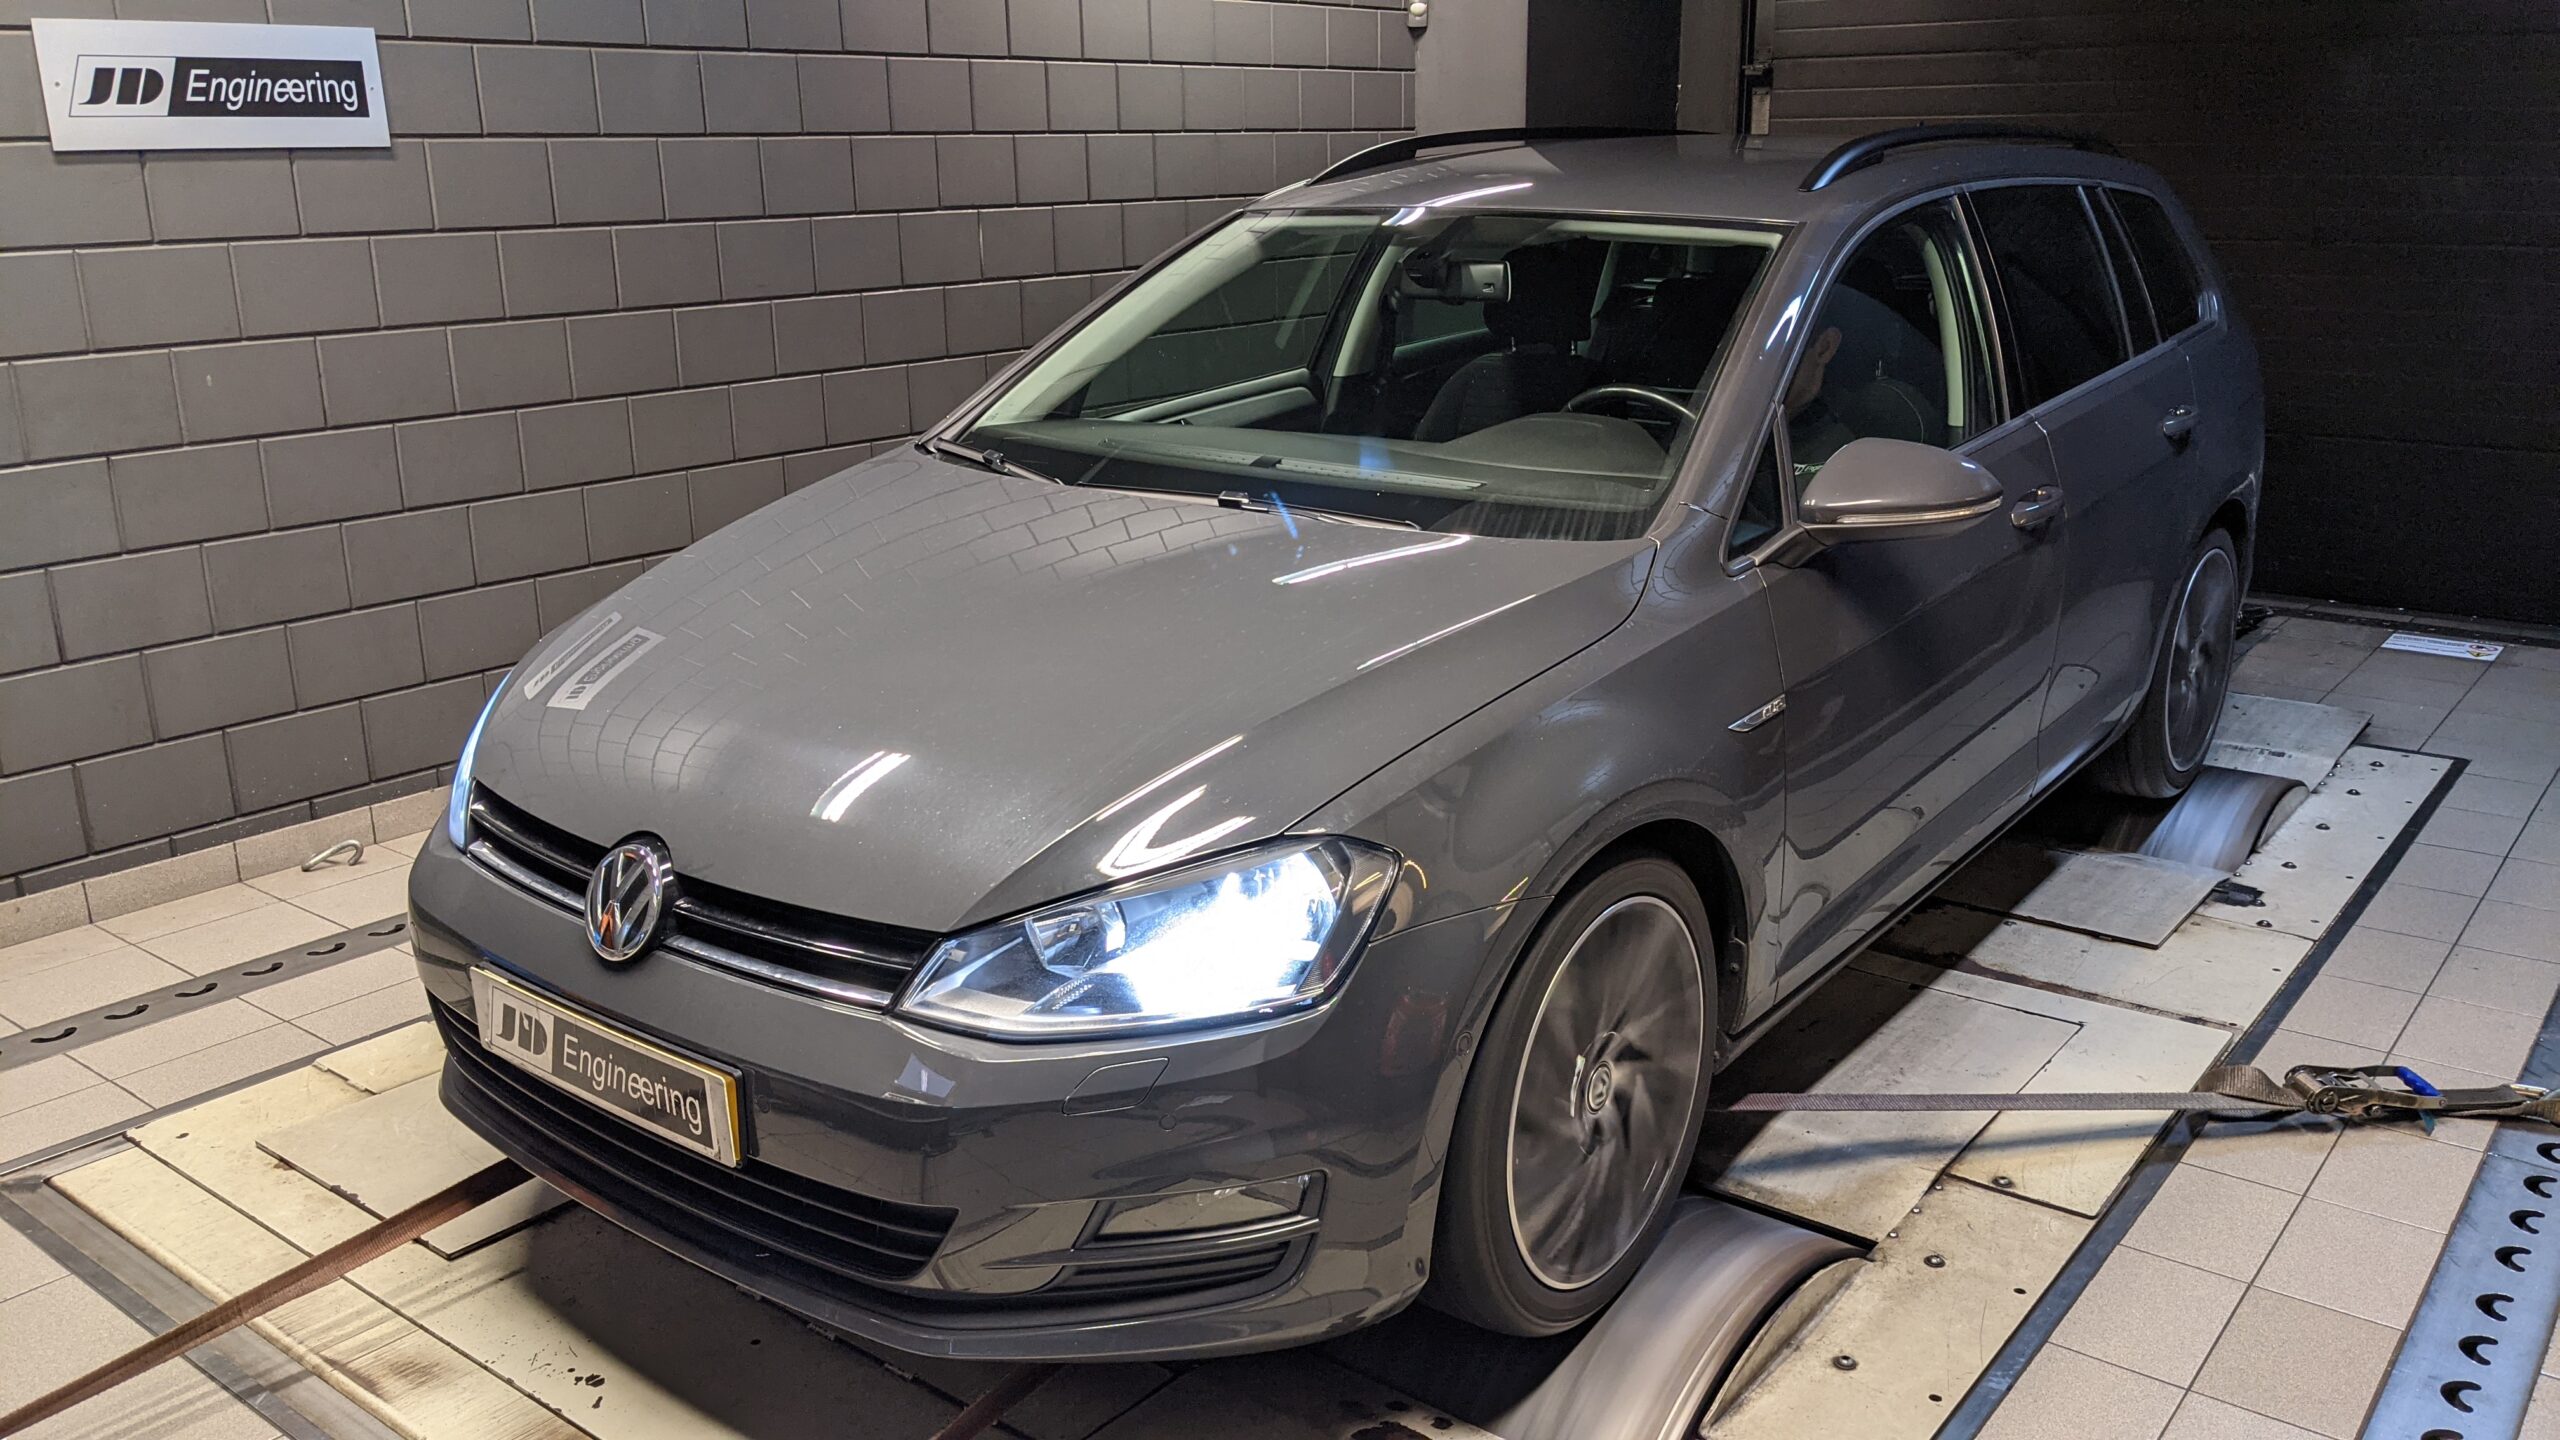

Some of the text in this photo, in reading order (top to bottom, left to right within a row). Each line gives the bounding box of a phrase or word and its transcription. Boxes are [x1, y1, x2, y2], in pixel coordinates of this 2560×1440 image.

[78, 67, 359, 112] JD Engineering
[495, 1002, 703, 1136] JD Engineering
